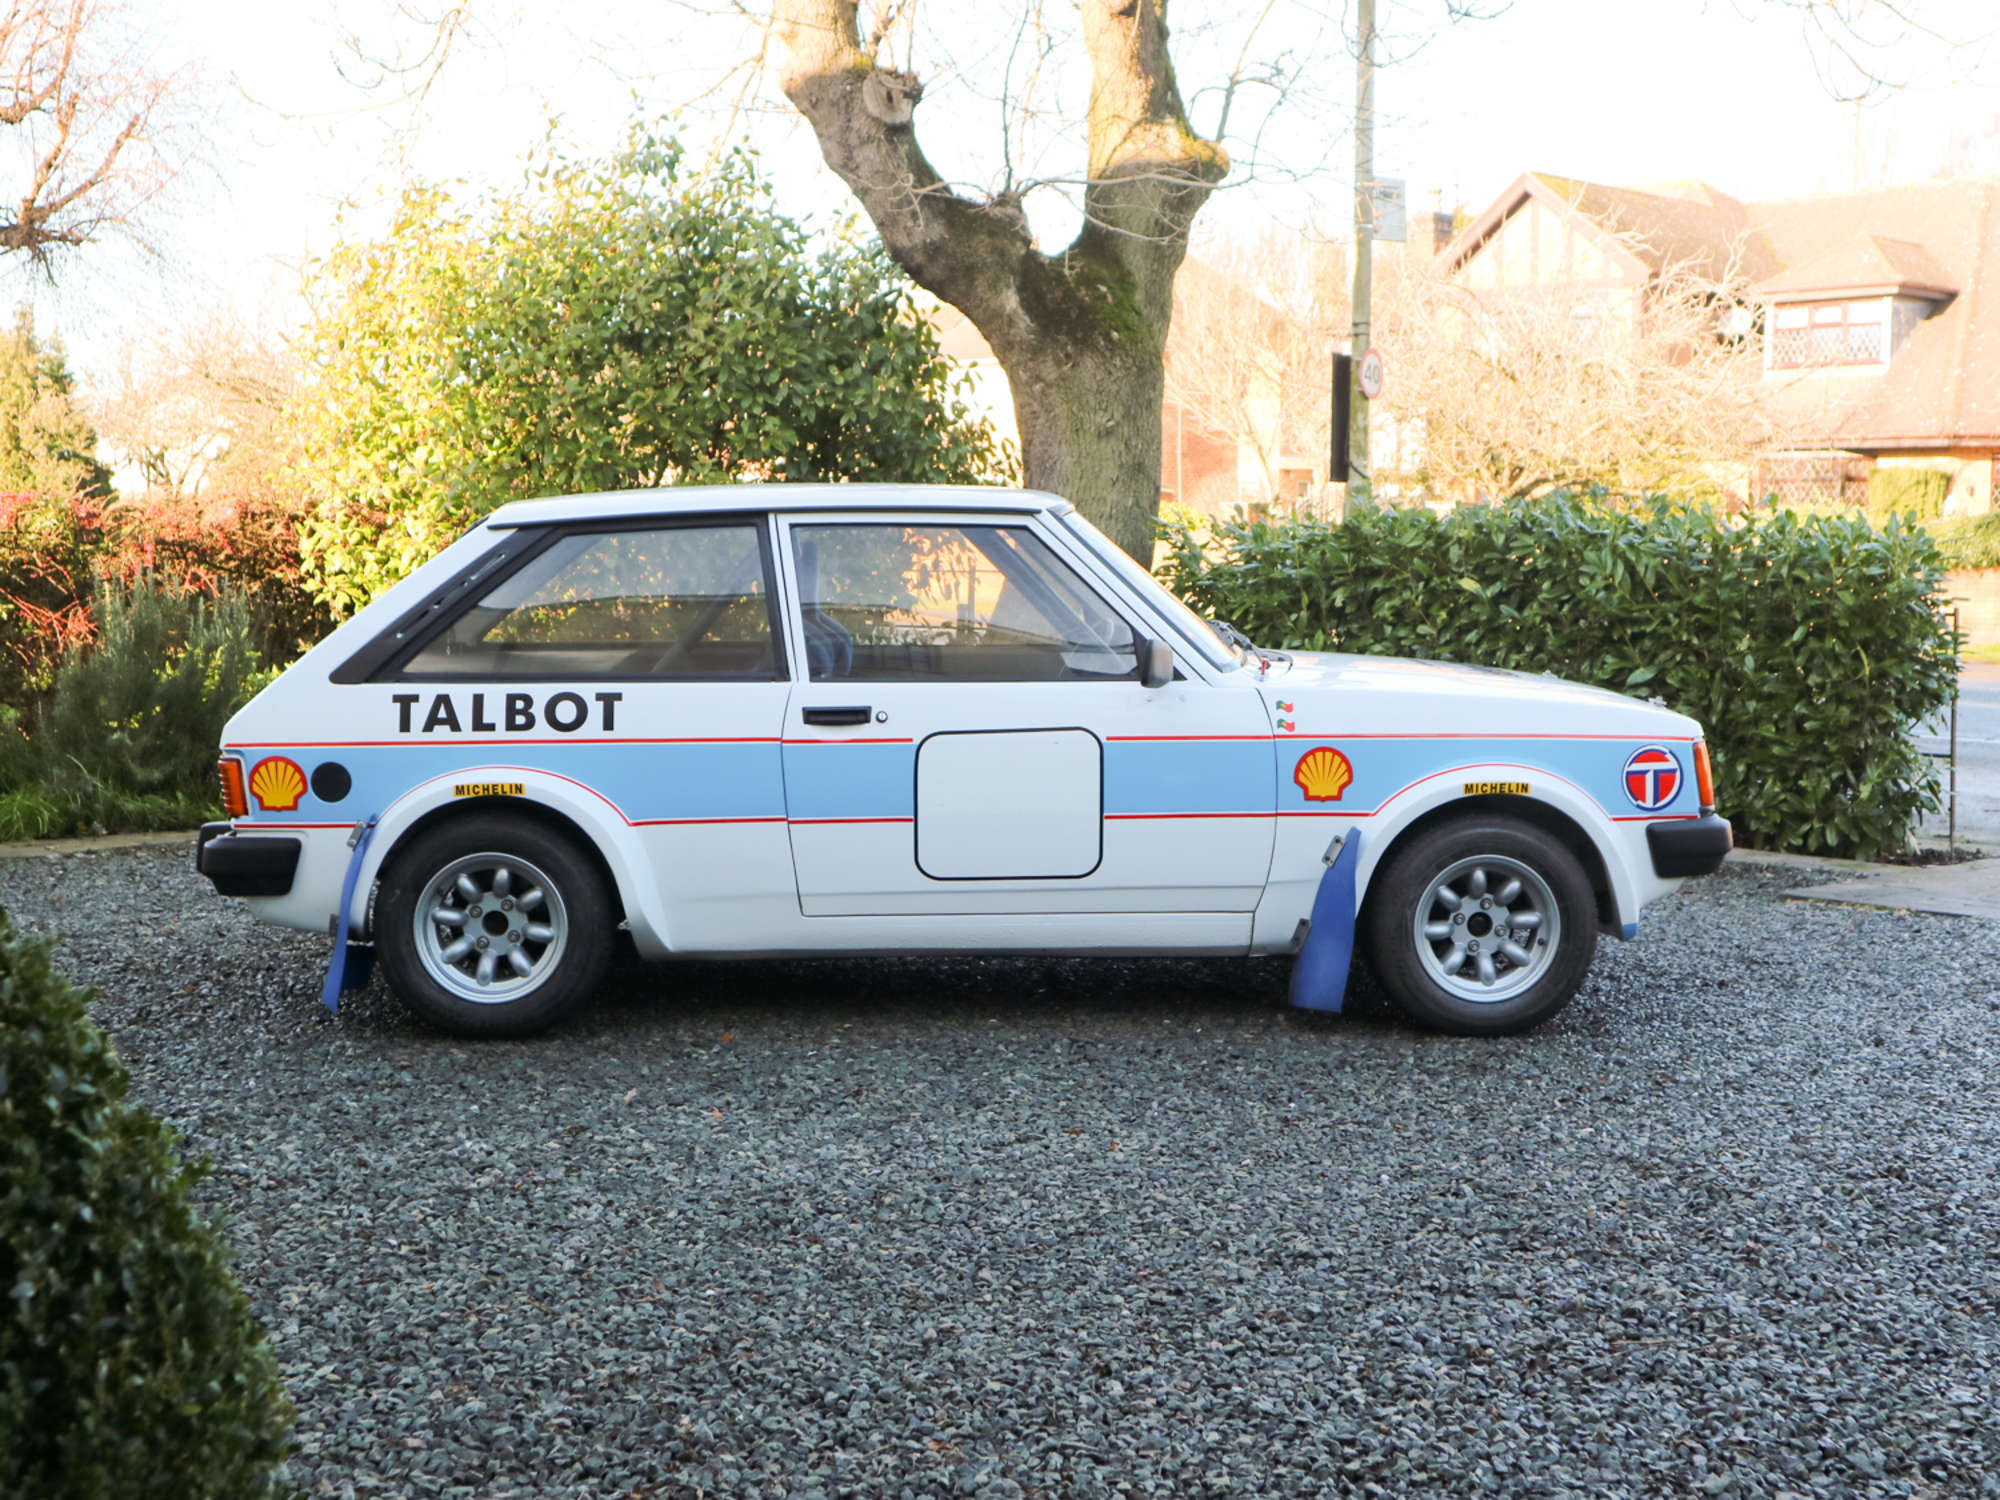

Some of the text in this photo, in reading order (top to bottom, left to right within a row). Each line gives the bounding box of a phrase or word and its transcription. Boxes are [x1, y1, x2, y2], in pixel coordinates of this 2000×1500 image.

[1364, 364, 1380, 384] 40
[392, 691, 623, 733] TALBOT
[455, 783, 523, 796] MICHELIN
[1464, 782, 1529, 794] MICHELIN
